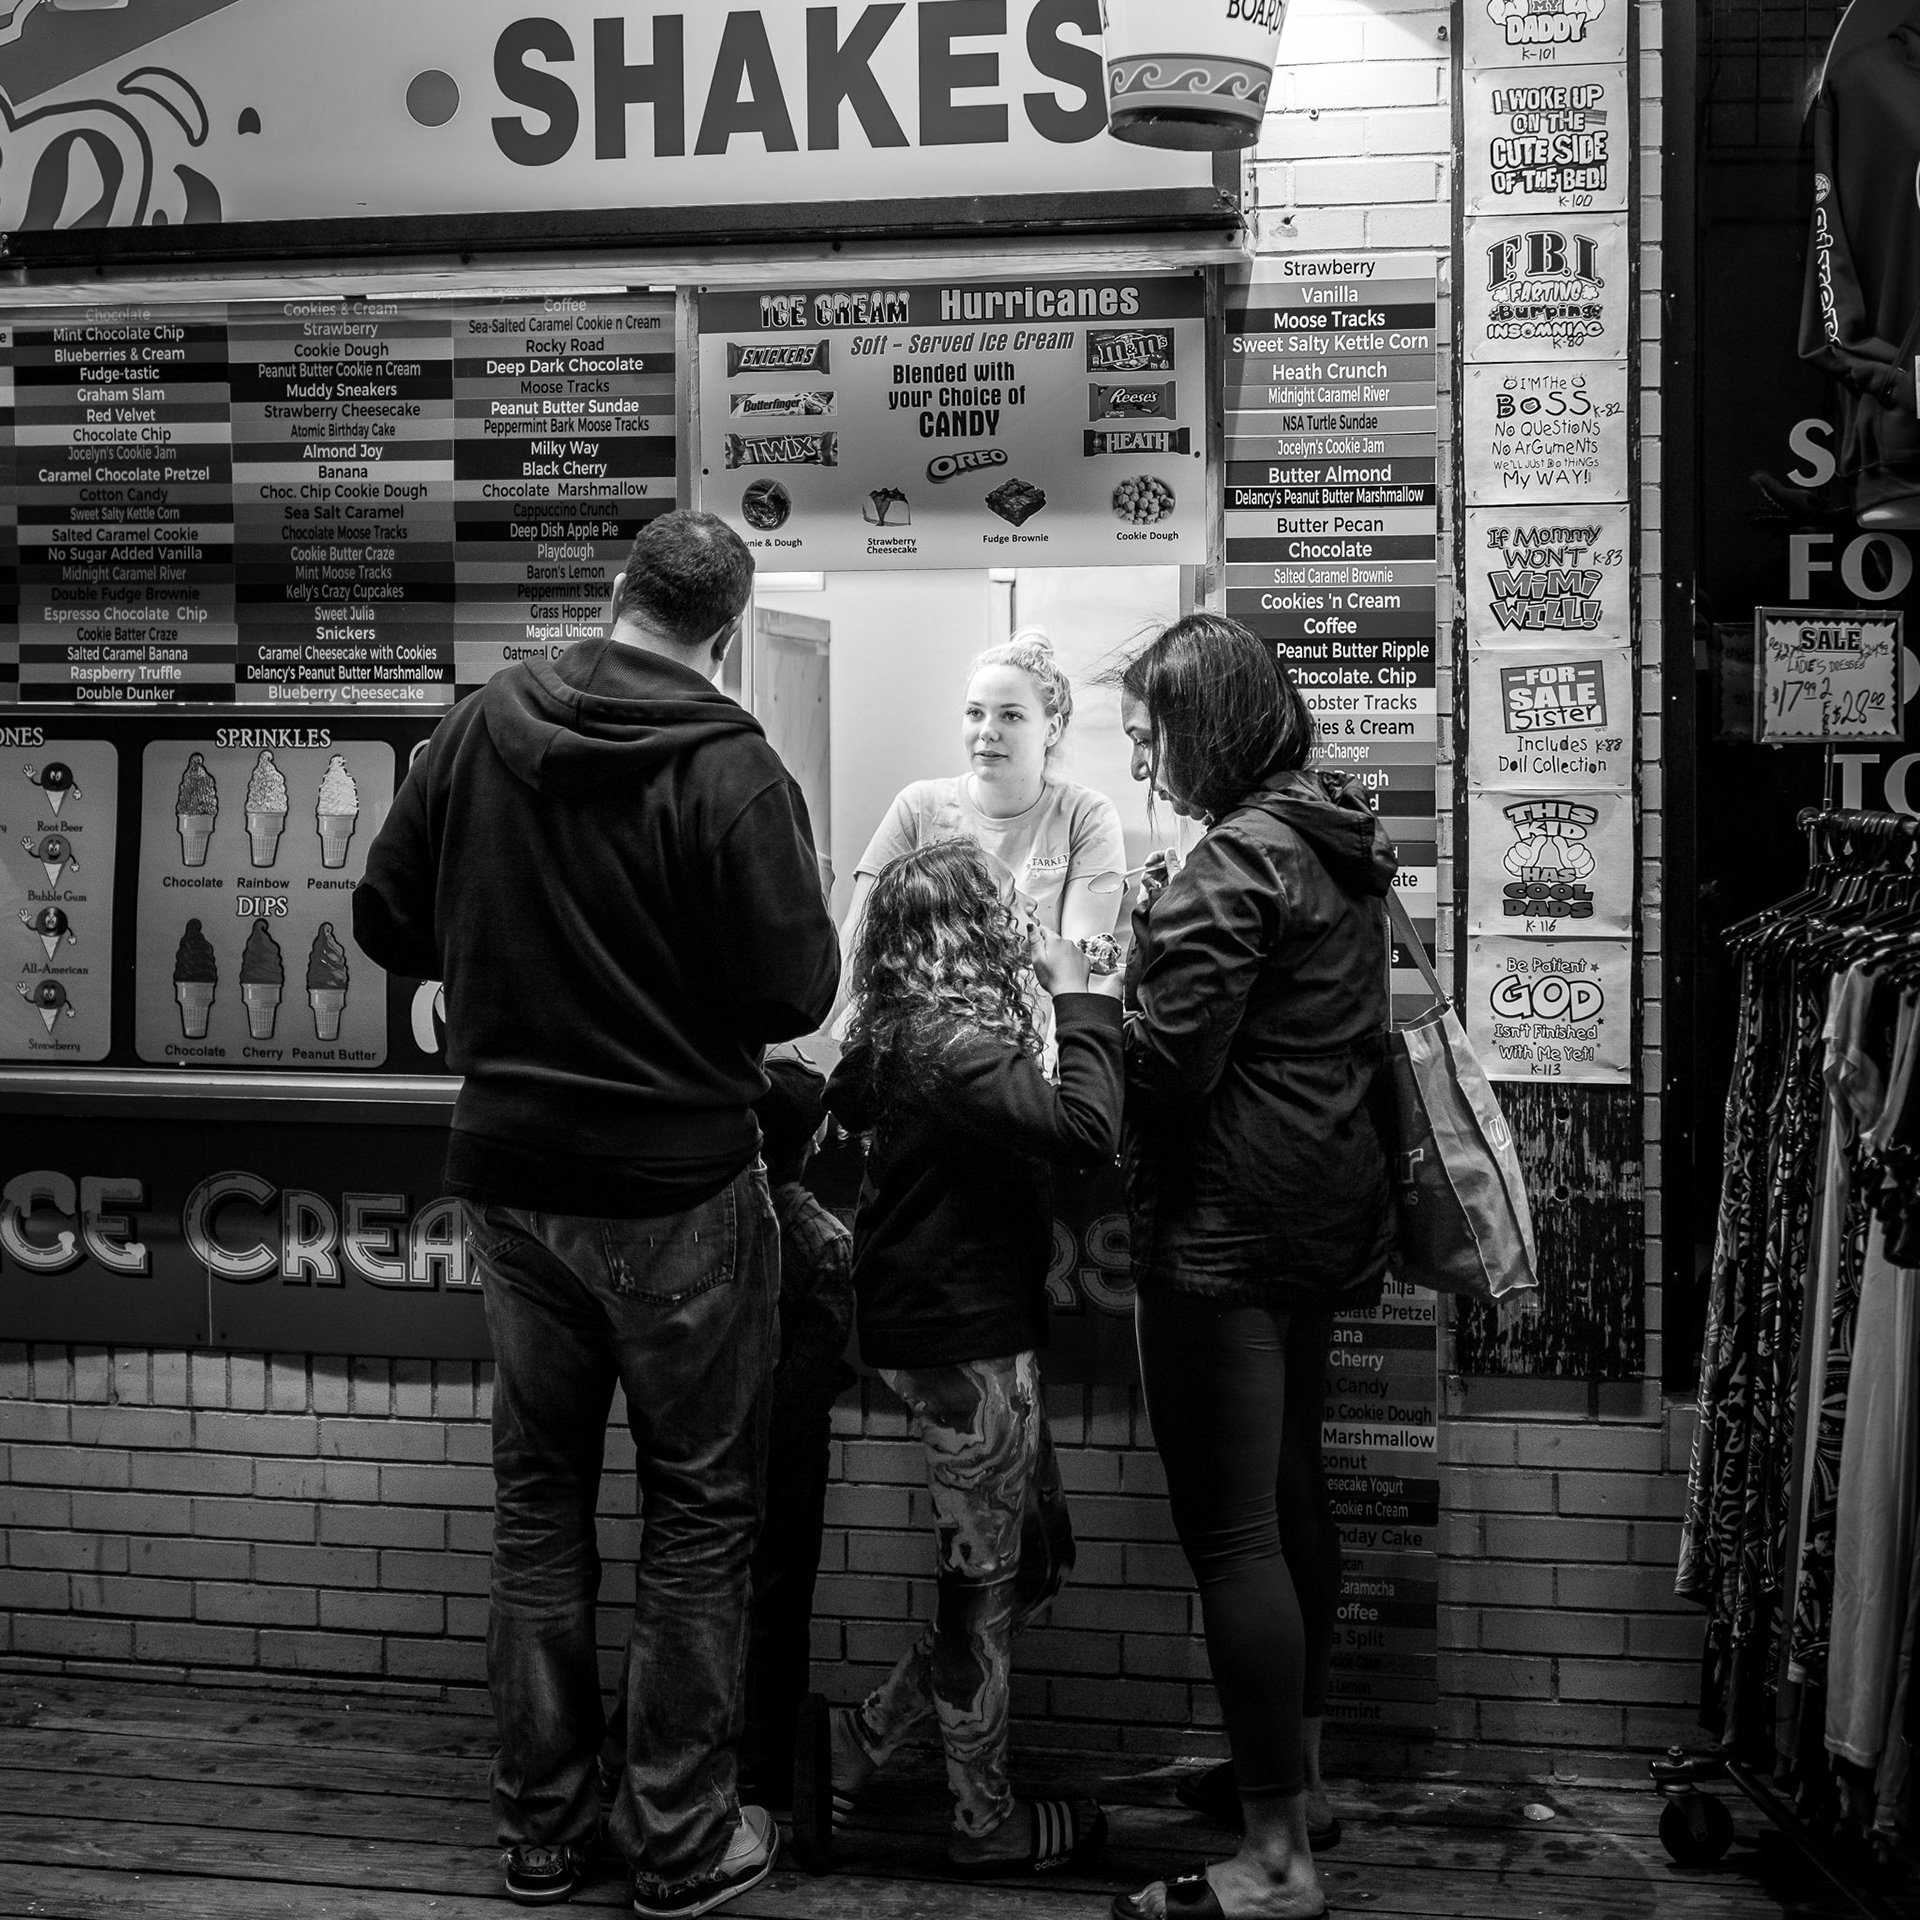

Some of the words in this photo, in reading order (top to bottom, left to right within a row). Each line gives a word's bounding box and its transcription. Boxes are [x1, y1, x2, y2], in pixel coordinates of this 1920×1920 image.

[1505, 13, 1586, 45] DADDY
[1522, 47, 1555, 60] K-101
[490, 0, 1107, 166] SHAKES
[1492, 89, 1503, 114] I
[1507, 87, 1566, 111] WOKE
[1572, 84, 1604, 110] UP
[1511, 113, 1540, 134] ON
[1546, 110, 1585, 133] THE
[1491, 136, 1551, 169] CUTE
[1551, 131, 1608, 165] SIDE
[1491, 171, 1516, 195] OF
[1522, 167, 1558, 193] THE
[1560, 166, 1608, 193] BED!
[1559, 195, 1593, 207] K-100
[1284, 260, 1375, 277] Strawberry
[1301, 286, 1358, 303] Vanilla
[1509, 280, 1584, 303] FARTING
[759, 294, 806, 327] ICE
[814, 291, 910, 325] CREAM
[940, 287, 1140, 321] Hurricanes
[1274, 312, 1326, 329] Moose
[1332, 310, 1385, 327] Tracks
[53, 327, 82, 341] Mint
[86, 326, 152, 340] Chocolate
[155, 325, 185, 342] Chip
[1487, 321, 1604, 340] INSOMNIAC
[294, 343, 340, 358] Cookie
[344, 342, 389, 358] Dough
[526, 339, 566, 355] Rocky
[569, 338, 604, 352] Road
[850, 334, 888, 357] Soft
[908, 331, 973, 353] Served
[979, 331, 1008, 351] Ice
[1013, 329, 1075, 351] Cream
[54, 347, 127, 362] Blueberries
[130, 349, 138, 361] &
[142, 346, 185, 360] Cream
[740, 346, 816, 367] SNICKERS
[80, 366, 160, 381] Fudge-tastic
[486, 360, 525, 377] Deep
[529, 359, 565, 373] Dark
[568, 357, 644, 372] Chocolate
[892, 364, 967, 385] Blended
[973, 362, 1015, 383] with
[1272, 363, 1322, 381] Heath
[1327, 361, 1387, 378] Crunch
[286, 383, 333, 400] Muddy
[337, 382, 397, 397] Sneakers
[521, 380, 564, 394] Moose
[567, 379, 610, 393] Tracks
[743, 396, 801, 414] Butterfinger
[888, 388, 932, 410] your
[939, 386, 1001, 407] Choice
[1007, 386, 1026, 406] of
[491, 401, 538, 415] Peanut
[542, 400, 585, 414] Butter
[588, 399, 639, 413] Sundae
[919, 410, 1000, 438] CANDY
[73, 428, 138, 442] Chocolate
[141, 427, 172, 444] Chip
[1105, 431, 1170, 452] HEATH
[303, 445, 356, 458] Almond
[359, 444, 383, 460] Joy
[531, 441, 566, 457] Milky
[568, 441, 599, 456] Way
[318, 466, 368, 478] Banana
[929, 449, 1008, 478] OREO
[39, 468, 93, 483] Caramel
[96, 467, 161, 481] Chocolate
[165, 466, 210, 480] Pretzel
[1269, 466, 1320, 483] Butter
[1325, 464, 1391, 482] Almond
[1277, 517, 1328, 533] Butter
[1334, 516, 1383, 532] Pecan
[52, 528, 92, 542] Salted
[96, 528, 152, 541] Caramel
[156, 527, 198, 541] Cookie
[774, 537, 803, 549] Dough
[867, 537, 917, 549] Strawberry
[983, 534, 1010, 545] Fudge
[1013, 533, 1049, 543] Brownie
[1116, 531, 1146, 541] Cookie
[1149, 530, 1179, 543] Dough
[537, 544, 594, 560] Playdough
[866, 545, 917, 555] Cheesecake
[1289, 541, 1372, 558] Chocolate
[1503, 547, 1589, 568] WON'T
[1274, 568, 1305, 584] Salted
[1308, 567, 1349, 584] Caramel
[1352, 567, 1393, 583] Brownie
[316, 626, 375, 640] Snickers
[526, 625, 562, 640] Magical
[565, 624, 603, 638] Unicorn
[1304, 618, 1357, 634] Coffee
[1800, 627, 1861, 652] SALE
[1277, 643, 1329, 659] Peanut
[1332, 642, 1378, 658] Butter
[1382, 642, 1429, 660] Ripple
[70, 667, 135, 681] Raspberry
[139, 666, 181, 680] Truffle
[1526, 667, 1576, 685] FOR
[76, 687, 123, 700] Double
[126, 687, 175, 700] Dunker
[268, 686, 338, 701] Blueberry
[342, 686, 424, 700] Cheesecake
[1509, 683, 1598, 710] SALE
[1514, 704, 1597, 731] Sister
[216, 729, 331, 749] SPRINKLES
[1518, 736, 1588, 752] Includes
[1499, 755, 1528, 773] Doll
[1533, 755, 1607, 774] Collection
[1502, 800, 1598, 825] THIS
[37, 821, 57, 832] Root
[60, 822, 83, 833] Beer
[1515, 821, 1587, 841] KID
[162, 876, 223, 888] Chocolate
[1522, 866, 1576, 883] HAS
[237, 878, 290, 889] Rainbow
[307, 878, 356, 890] Peanuts
[1503, 883, 1594, 901] COOL
[28, 891, 62, 901] Bubble
[64, 891, 87, 902] Gum
[237, 897, 288, 917] DIPS
[1503, 900, 1594, 919] DADS
[21, 964, 89, 975] All-American
[1507, 958, 1528, 972] Be
[1532, 958, 1587, 973] Patient
[1490, 975, 1604, 1022] GOD
[1494, 1024, 1530, 1038] Isn't
[1533, 1024, 1598, 1040] Finished
[28, 1040, 81, 1052] Strawberry
[165, 1045, 226, 1058] Chocolate
[242, 1047, 283, 1061] Cherry
[292, 1048, 335, 1060] Peanut
[339, 1049, 376, 1061] Butter
[1499, 1045, 1533, 1060] With
[1537, 1046, 1561, 1061] Me
[1564, 1046, 1594, 1061] Yet!
[1531, 1063, 1561, 1076] K-113
[1329, 1352, 1384, 1372] Cherry
[1322, 1429, 1435, 1449] Marshmallow
